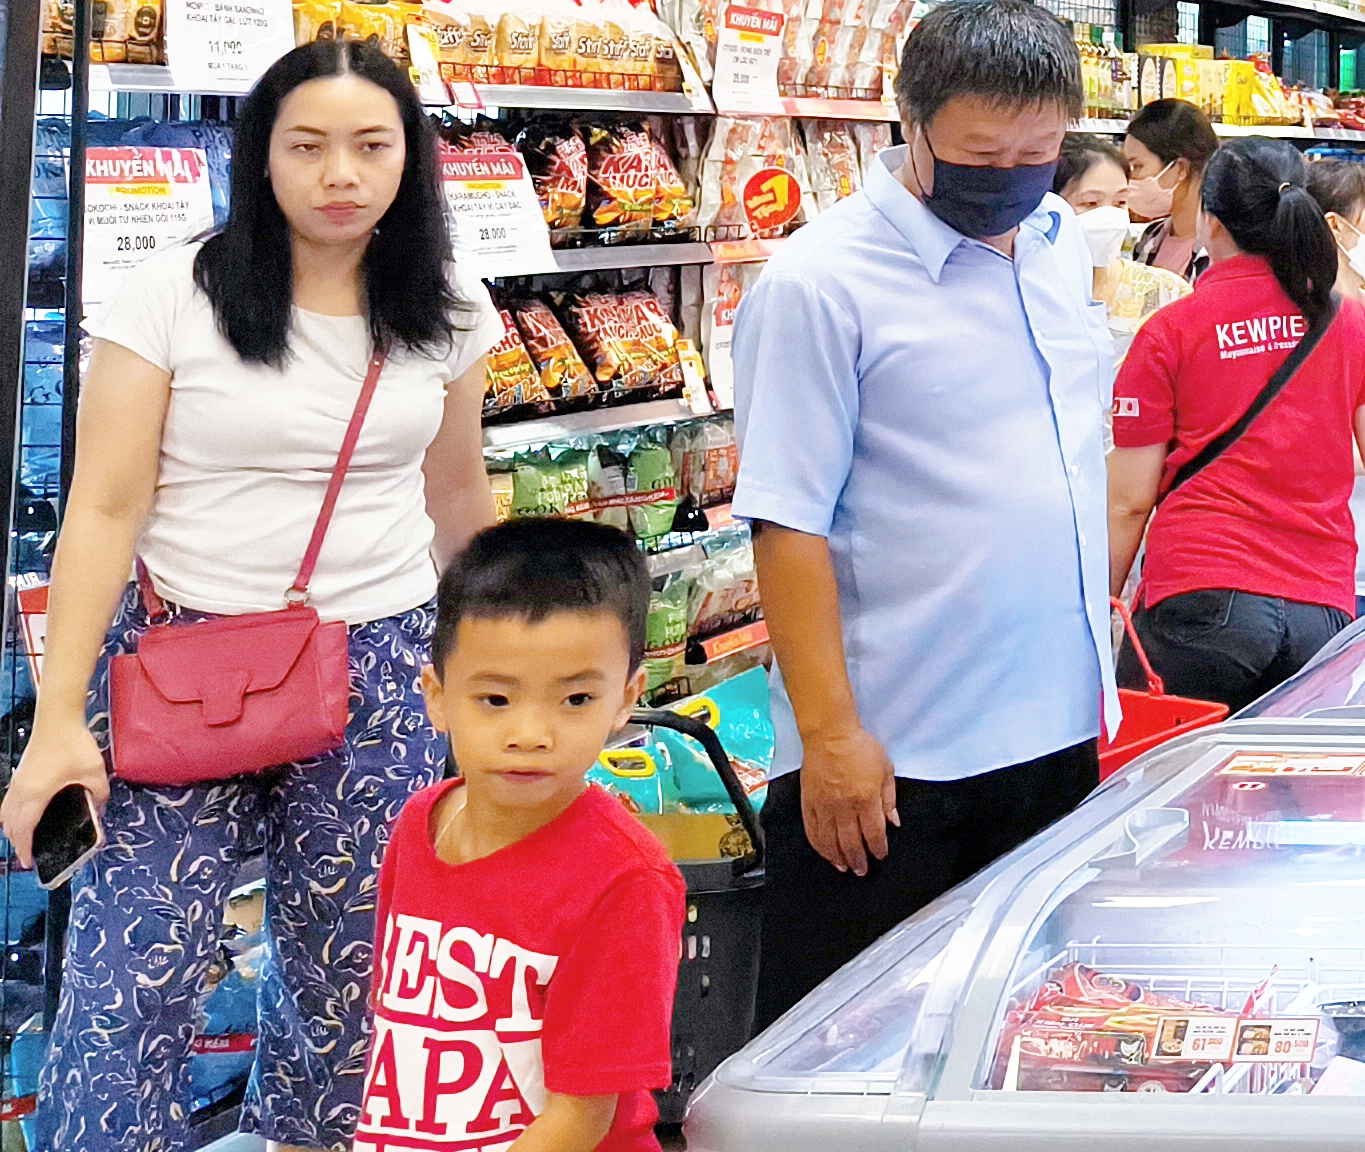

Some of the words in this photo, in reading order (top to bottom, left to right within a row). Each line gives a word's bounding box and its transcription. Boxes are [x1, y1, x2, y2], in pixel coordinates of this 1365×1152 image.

[730, 11, 761, 29] KHUYẾN
[85, 150, 155, 178] KHUYẾN
[443, 158, 490, 176] KHUYẾN
[493, 158, 515, 176] MÃI
[124, 203, 150, 212] SNACK
[479, 228, 507, 241] 28,000
[117, 235, 156, 252] 28,000
[1215, 315, 1305, 350] KEWPIE
[377, 912, 560, 1032] EST
[1192, 1037, 1206, 1051] 61
[1275, 1040, 1291, 1054] 80
